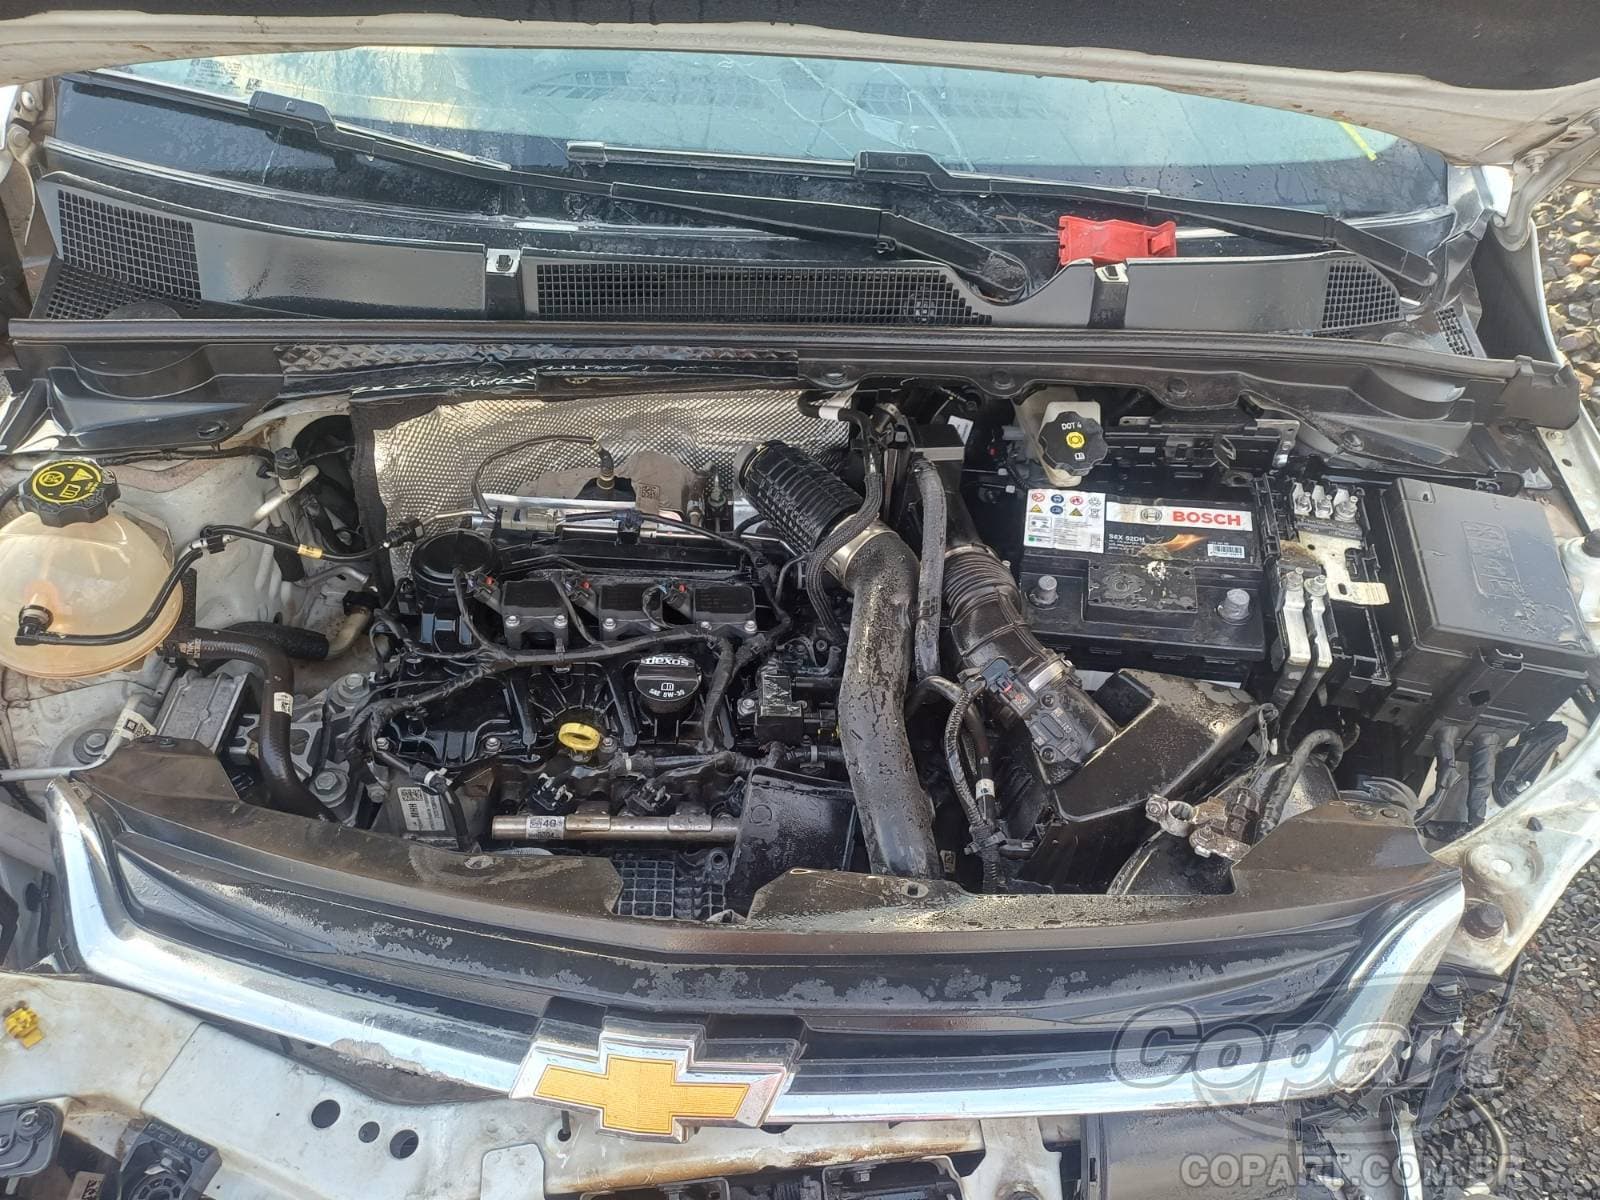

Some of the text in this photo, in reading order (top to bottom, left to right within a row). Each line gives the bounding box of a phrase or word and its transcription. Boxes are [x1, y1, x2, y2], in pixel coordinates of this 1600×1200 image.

[1061, 422, 1075, 430] DOT
[1172, 511, 1241, 526] BOSCH
[645, 655, 689, 666] dexos
